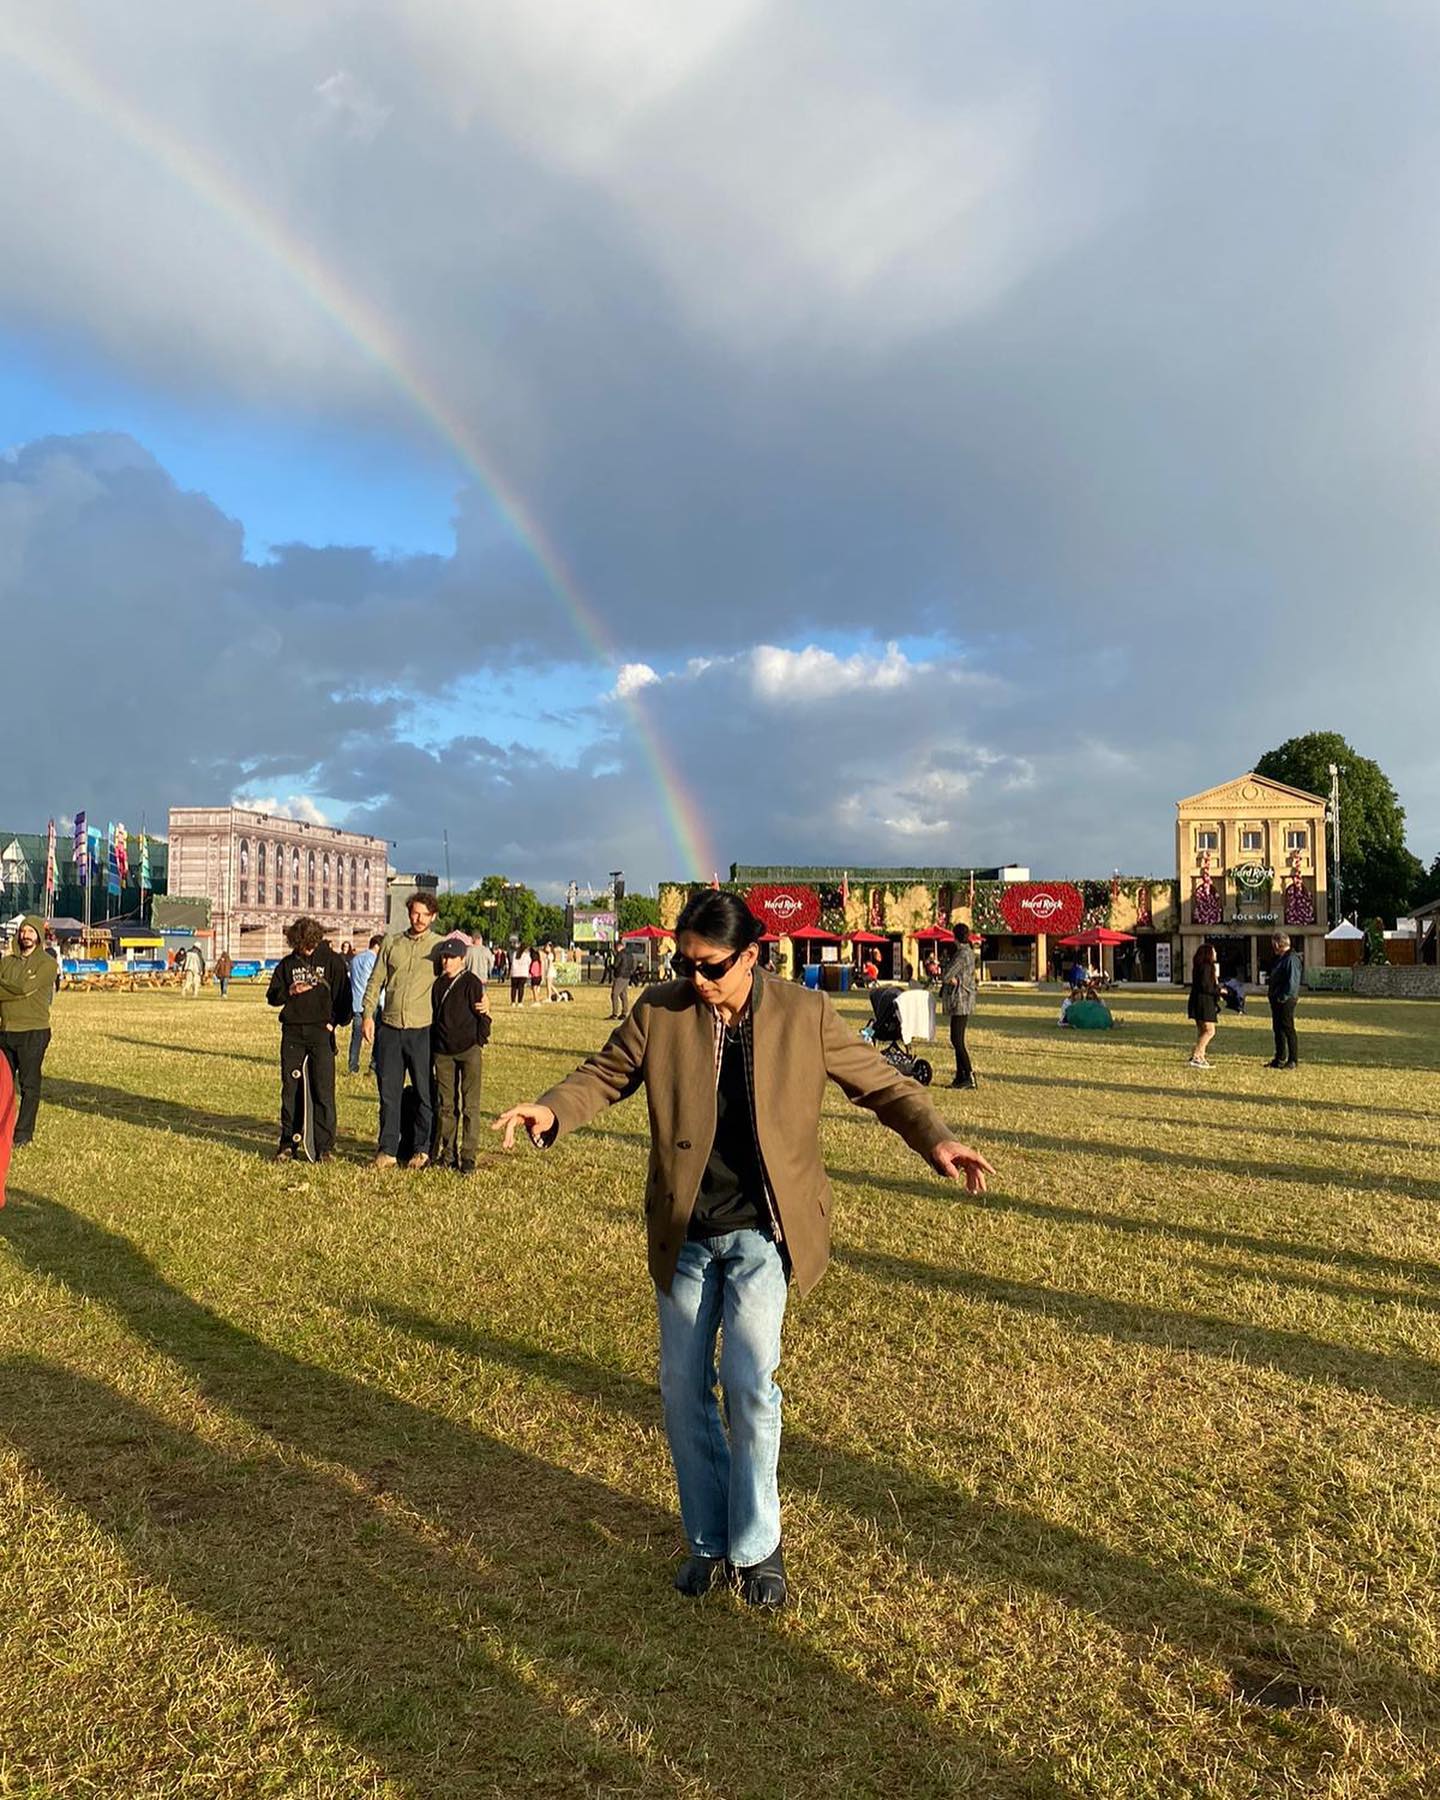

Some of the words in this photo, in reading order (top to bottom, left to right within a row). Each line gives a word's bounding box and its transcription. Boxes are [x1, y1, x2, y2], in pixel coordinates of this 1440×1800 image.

[1230, 867, 1252, 878] Hard
[1252, 867, 1274, 879] Rock
[764, 899, 784, 909] Hard
[784, 899, 803, 911] Rock
[1021, 899, 1042, 909] Hard
[1043, 899, 1063, 910] Rock
[1232, 913, 1254, 921] ROCK
[1256, 913, 1279, 921] SHOP
